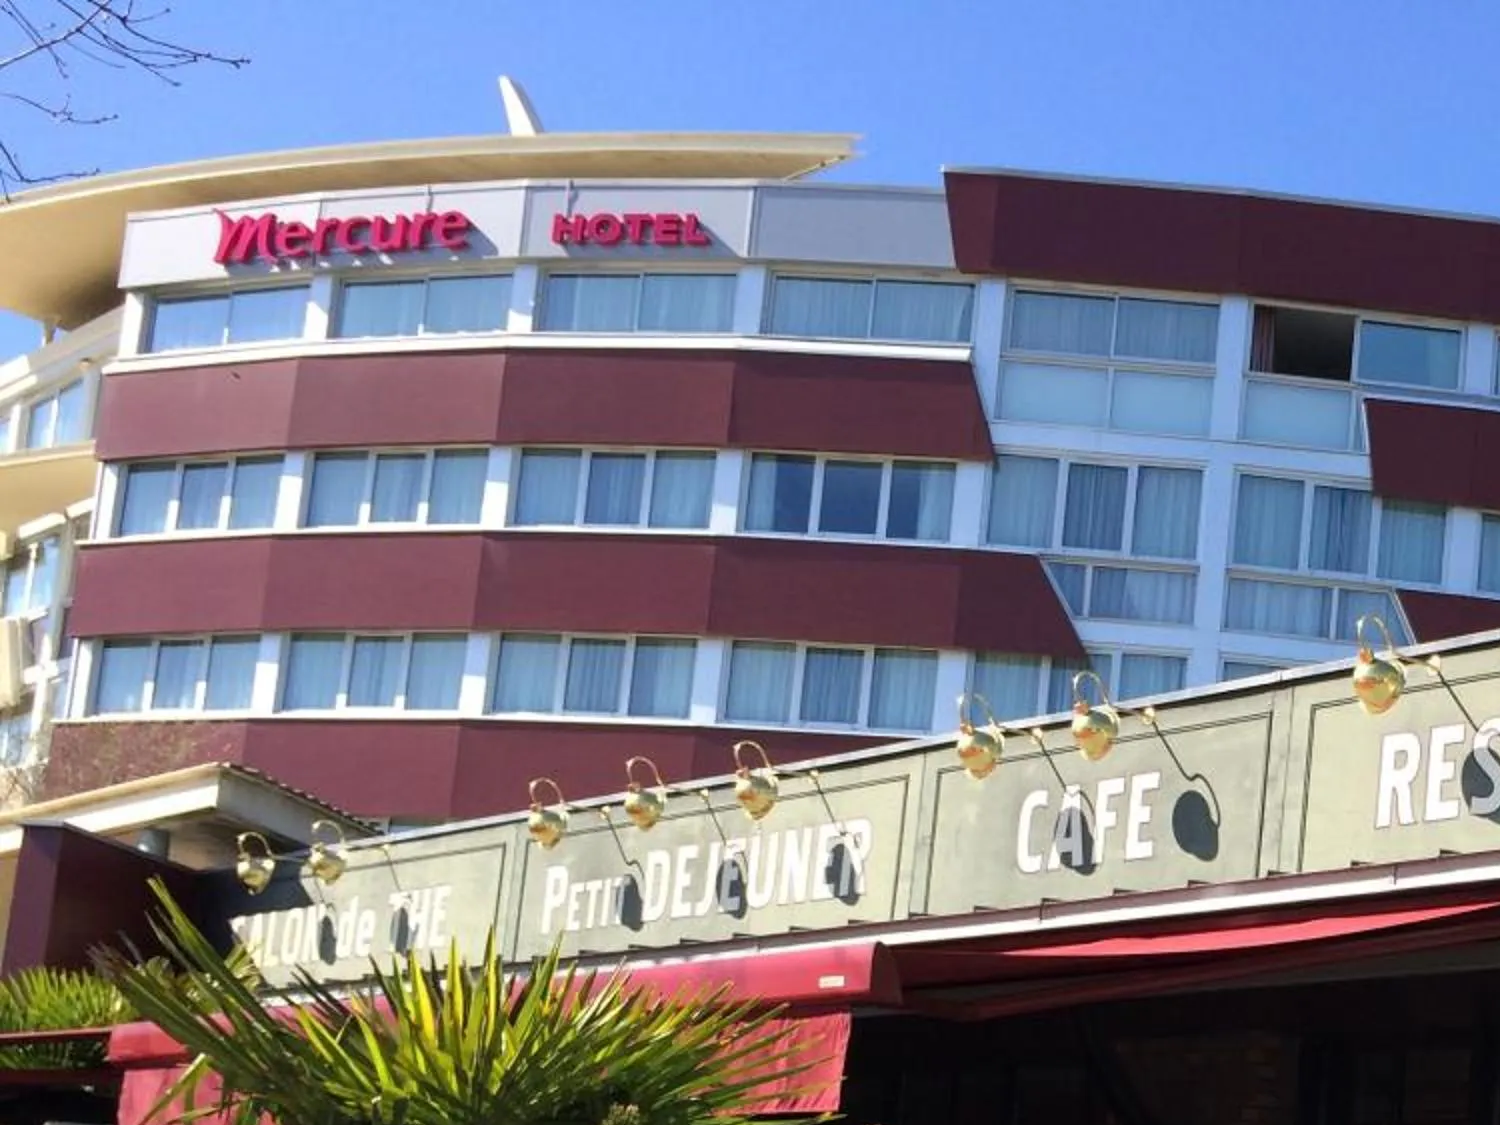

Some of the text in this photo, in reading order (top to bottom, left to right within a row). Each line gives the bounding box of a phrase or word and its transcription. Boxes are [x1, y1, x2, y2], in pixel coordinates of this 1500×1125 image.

[213, 208, 708, 264] Mercure HOTEL
[1016, 772, 1161, 874] CAFE
[645, 818, 874, 921] DEJEUNER
[336, 895, 376, 958] de
